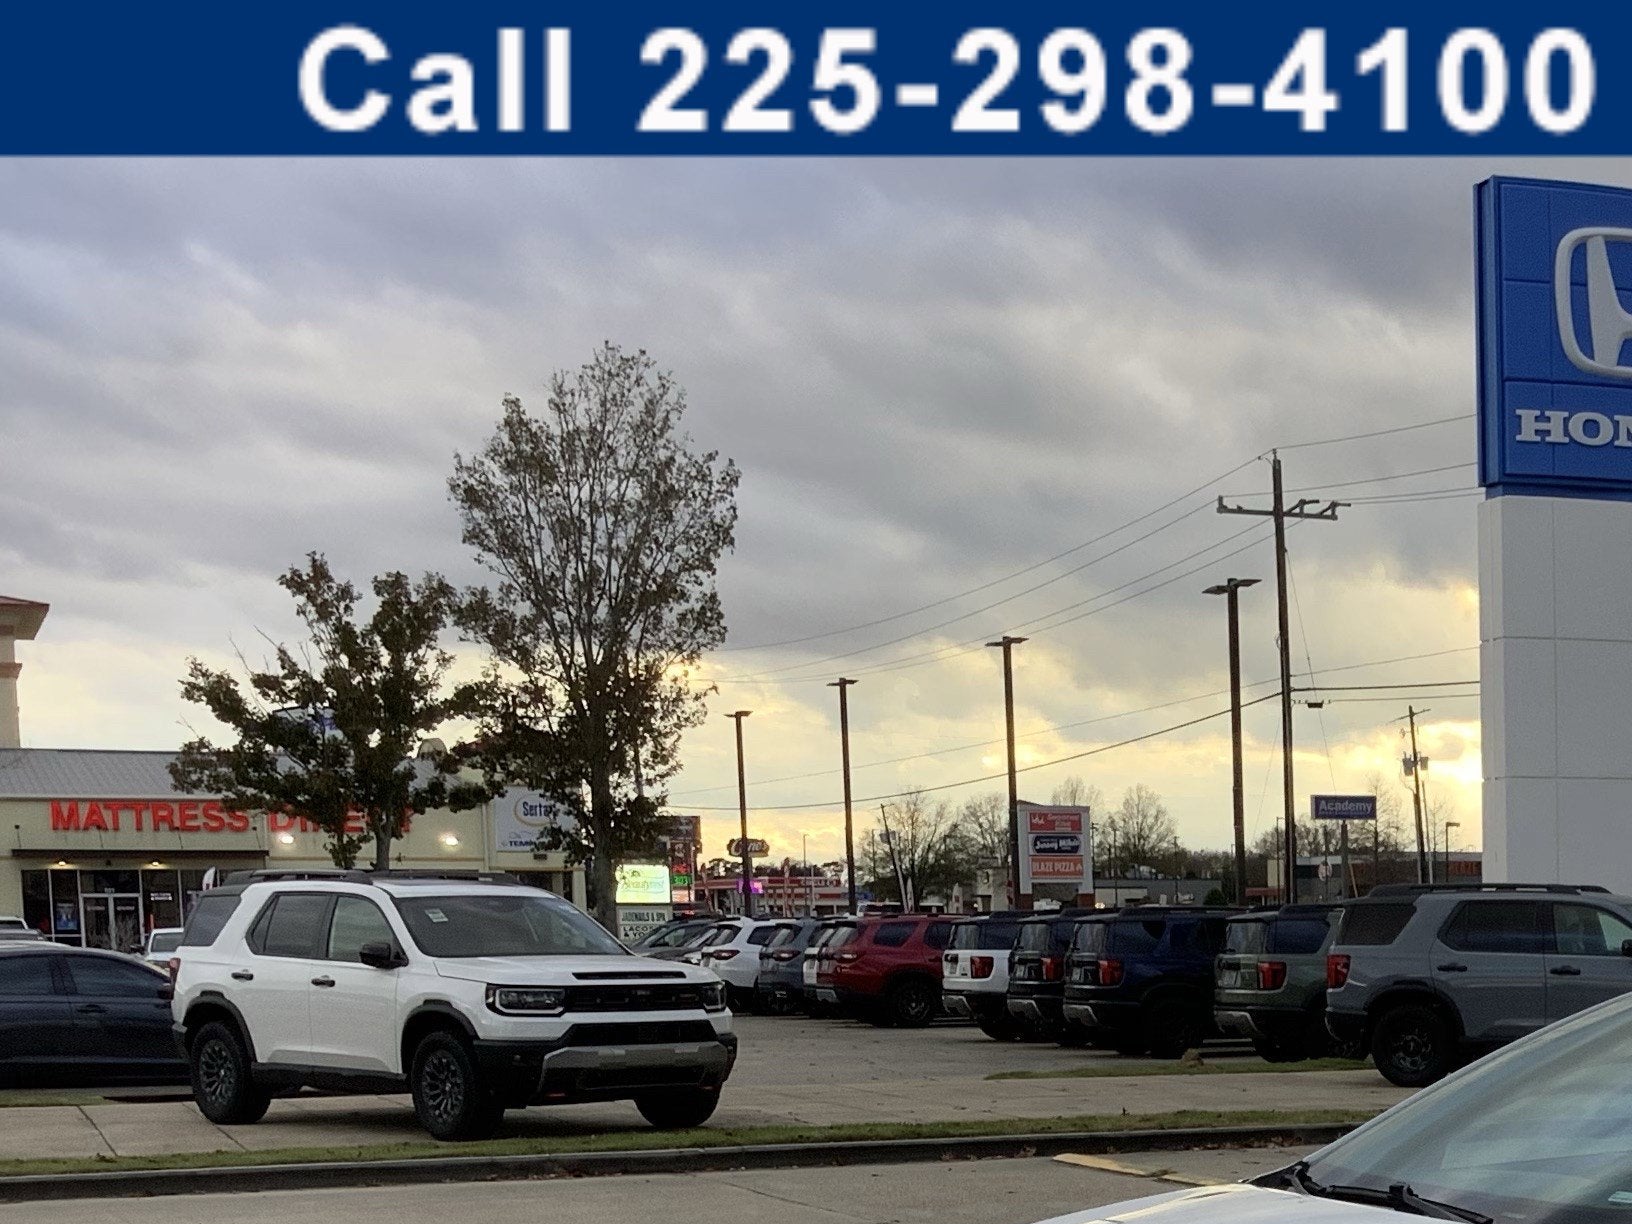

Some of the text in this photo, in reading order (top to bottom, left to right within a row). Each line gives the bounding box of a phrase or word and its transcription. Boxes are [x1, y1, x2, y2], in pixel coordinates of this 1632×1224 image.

[1319, 800, 1372, 814] Academy
[51, 801, 249, 831] MATTRESS
[1032, 861, 1075, 872] BLAZE PIZZA
